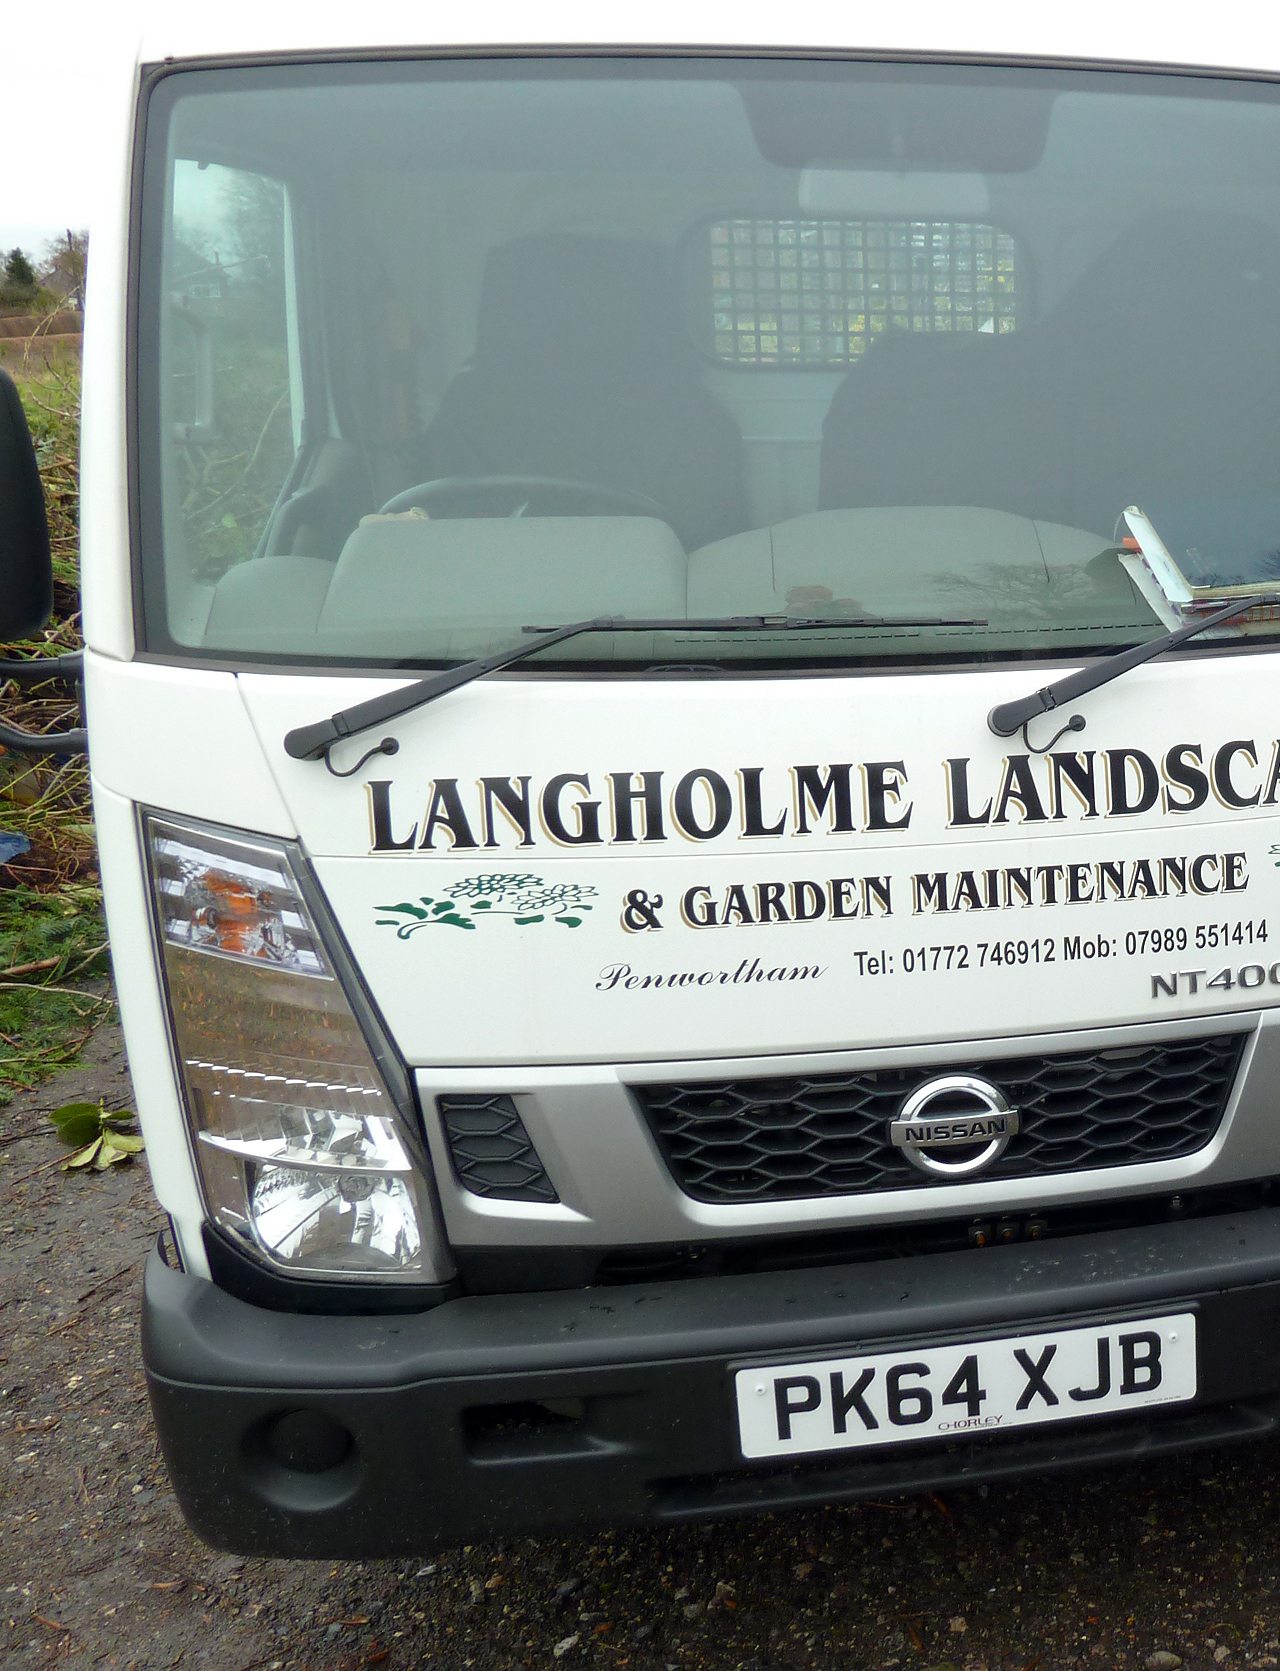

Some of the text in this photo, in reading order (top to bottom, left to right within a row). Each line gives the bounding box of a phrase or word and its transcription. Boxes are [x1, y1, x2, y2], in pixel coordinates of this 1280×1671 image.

[365, 760, 914, 855] LANGHOLME
[620, 852, 1250, 935] & GARDEN MAINTENANCE
[594, 958, 829, 992] Penwortham
[853, 919, 1269, 977] Tel: 01772 746912 Mob: 07989 551414
[905, 1119, 1006, 1143] NISSAN
[773, 1331, 1164, 1441] PK64 XJB
[938, 1415, 1004, 1431] CHORLEY
